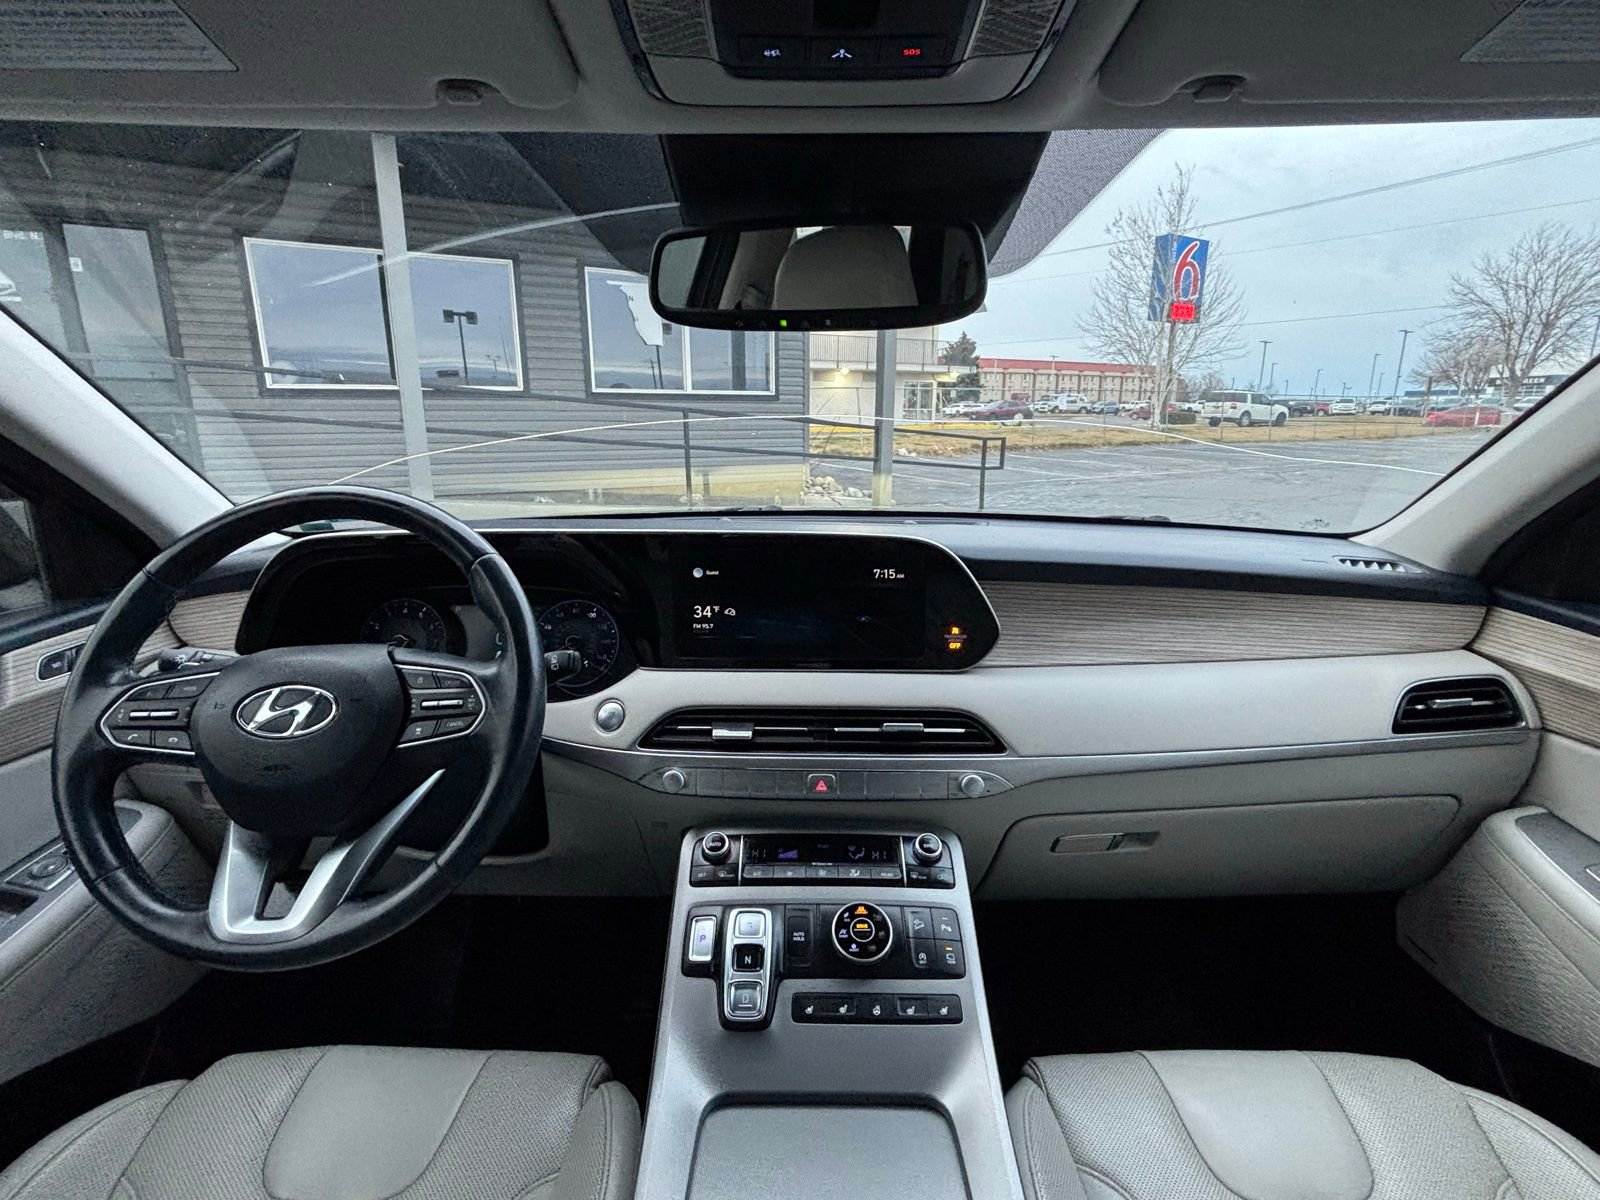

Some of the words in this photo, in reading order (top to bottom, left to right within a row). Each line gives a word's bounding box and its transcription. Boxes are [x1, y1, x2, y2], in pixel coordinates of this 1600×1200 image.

[903, 48, 921, 56] SOS
[1173, 240, 1201, 302] 6
[873, 568, 896, 579] 7:15
[699, 935, 706, 943] P
[744, 955, 752, 965] N
[742, 994, 750, 1003] D
